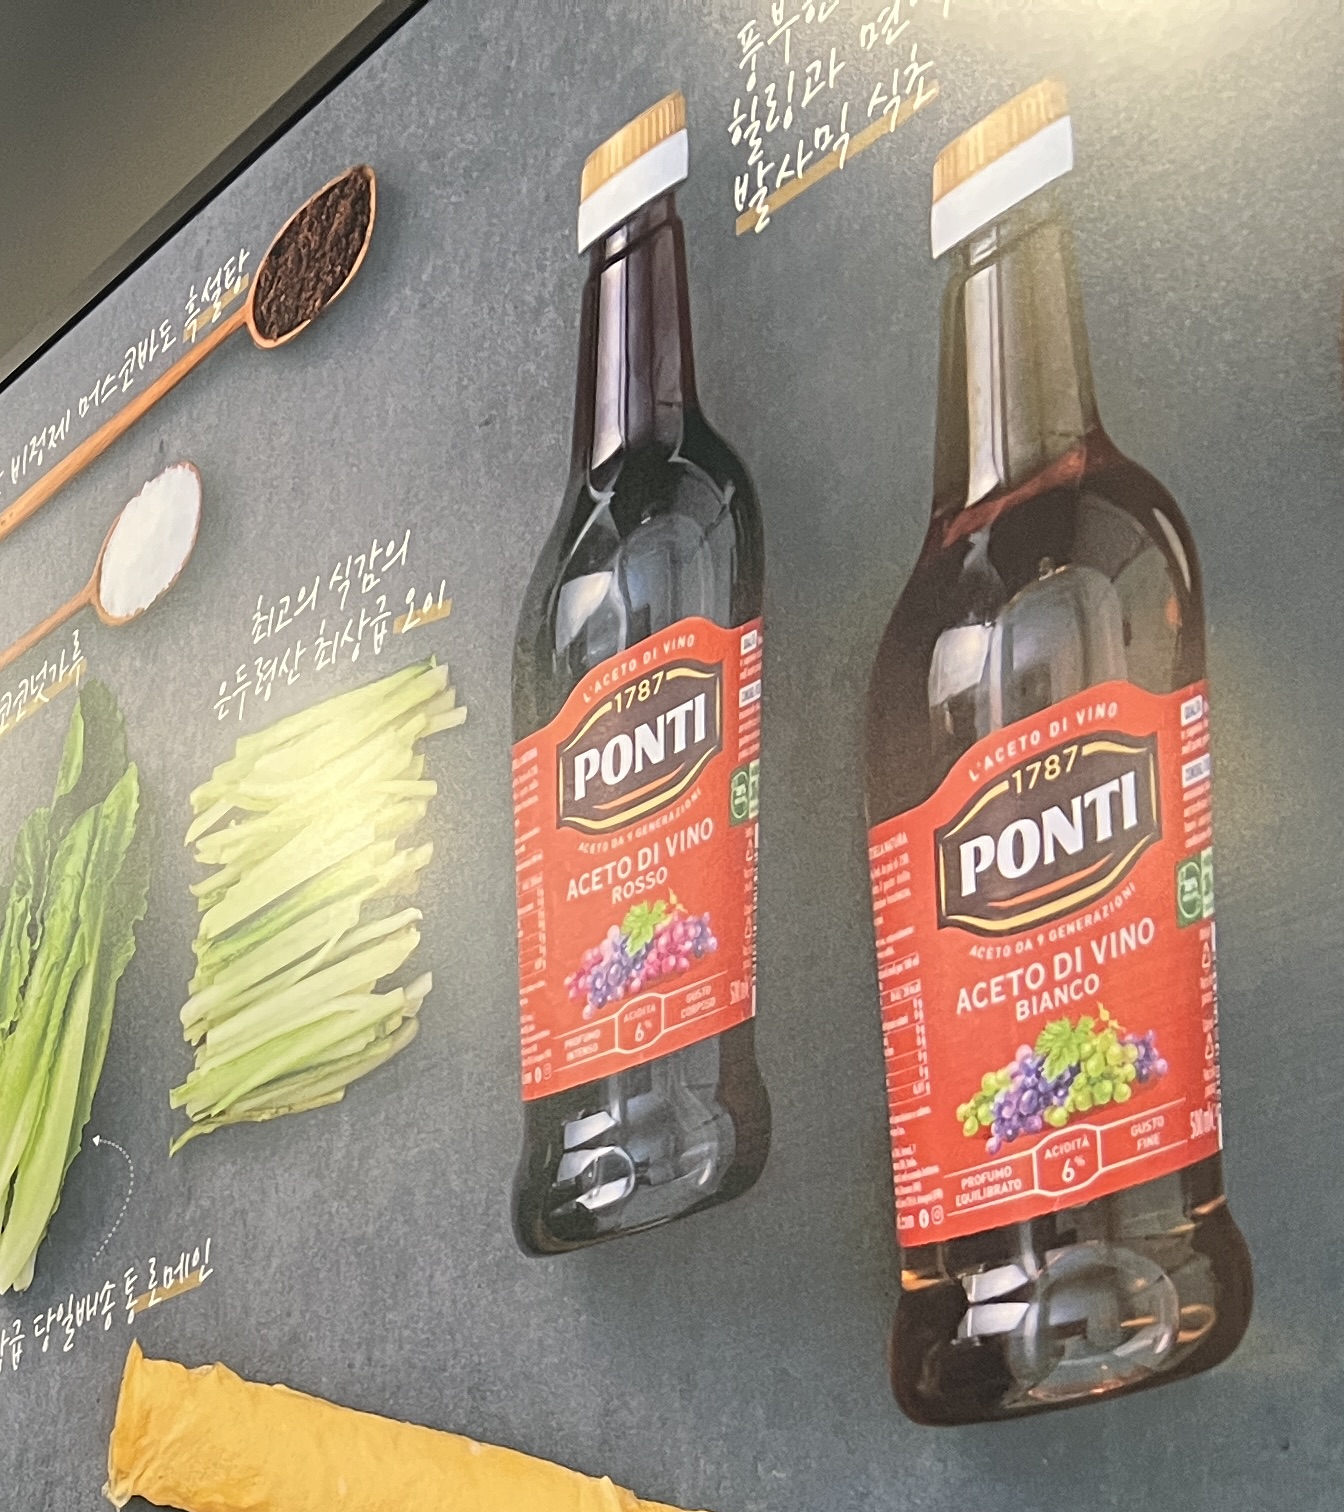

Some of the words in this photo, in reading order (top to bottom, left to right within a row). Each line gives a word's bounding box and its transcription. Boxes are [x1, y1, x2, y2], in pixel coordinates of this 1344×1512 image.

[728, 47, 845, 165] 힐링과
[734, 102, 850, 233] 발사믹
[867, 43, 937, 132] 식초
[11, 410, 71, 484] 비정제
[78, 319, 177, 418] 머스코바도
[184, 248, 250, 343] 흑설탕
[252, 575, 320, 644] 최고의
[329, 529, 410, 610] 식감의
[315, 595, 391, 671] 최상급
[402, 579, 446, 633] 오이
[643, 649, 657, 665] DI
[663, 634, 695, 655] VINO
[614, 670, 665, 714] 1787
[574, 692, 706, 801] PONTI
[968, 730, 1042, 782] L'ACETO
[1049, 718, 1068, 738] DI
[1076, 702, 1118, 725] VINO
[1012, 746, 1078, 793] 1787
[566, 855, 632, 901] ACETO
[638, 844, 659, 871] DI
[666, 817, 713, 858] VINO
[960, 771, 1139, 897] PONTI
[612, 866, 668, 904] ROSSO
[969, 944, 1012, 959] ACETO
[1048, 882, 1136, 941] GENERAZIONI
[956, 963, 1045, 1015] ACETO
[1053, 947, 1083, 981] DI
[1091, 917, 1155, 965] VINO
[1016, 973, 1100, 1021] BIANCO
[33, 1280, 116, 1353] 당일배송
